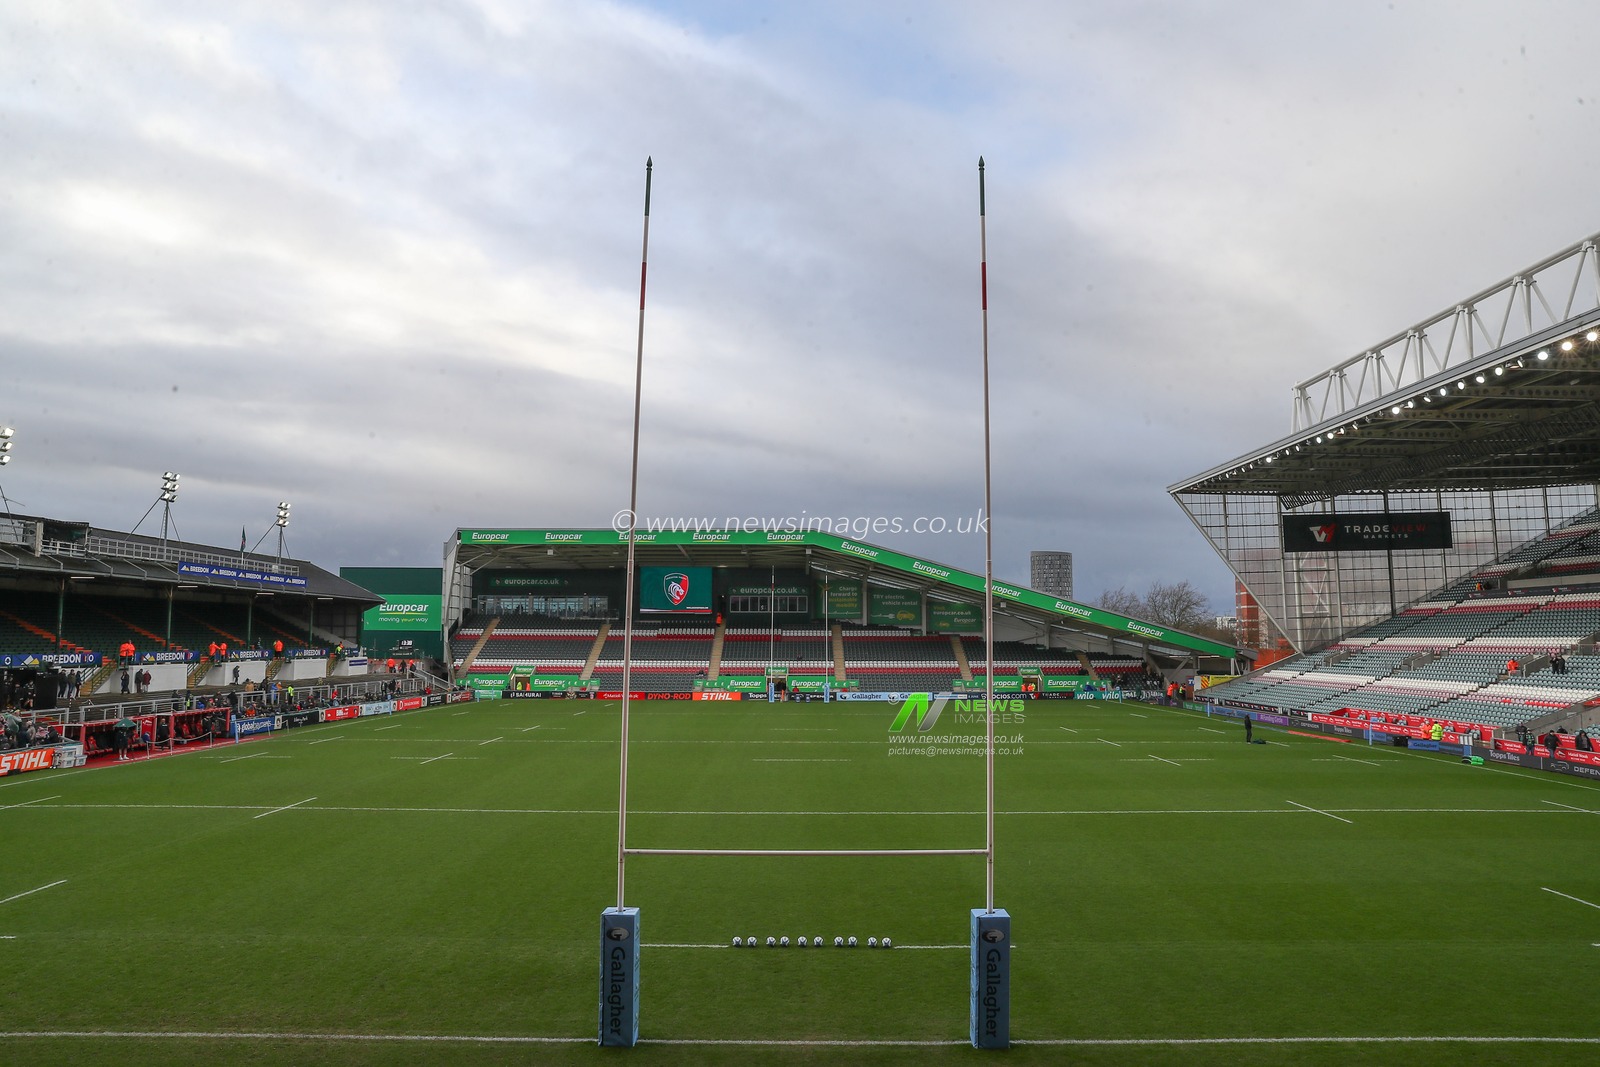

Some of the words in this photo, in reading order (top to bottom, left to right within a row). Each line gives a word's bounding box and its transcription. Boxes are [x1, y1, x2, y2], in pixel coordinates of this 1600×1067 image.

[472, 532, 509, 541] Europcar
[545, 532, 582, 541] Europcar
[692, 533, 730, 542] Europcar
[767, 533, 805, 542] Europcar
[841, 542, 878, 557] Europcar
[912, 562, 950, 577] Europcar
[504, 578, 559, 586] europcar.co.uk
[379, 602, 429, 614] Europcar
[1055, 601, 1092, 616] Europcar
[1127, 621, 1164, 636] Europcar
[156, 652, 185, 662] BREEDON
[239, 650, 263, 659] BREEDON
[304, 649, 321, 658] BREEDON
[730, 680, 762, 688] Europcar
[791, 680, 823, 688] Europcar
[1047, 679, 1079, 687] Europcar
[1077, 691, 1095, 700] wilo
[1489, 750, 1507, 760] Topps
[1507, 752, 1520, 761] Tiles
[0, 752, 49, 773] STIHL
[607, 947, 626, 1037] Gallagher
[983, 949, 1001, 1038] Gallagher
